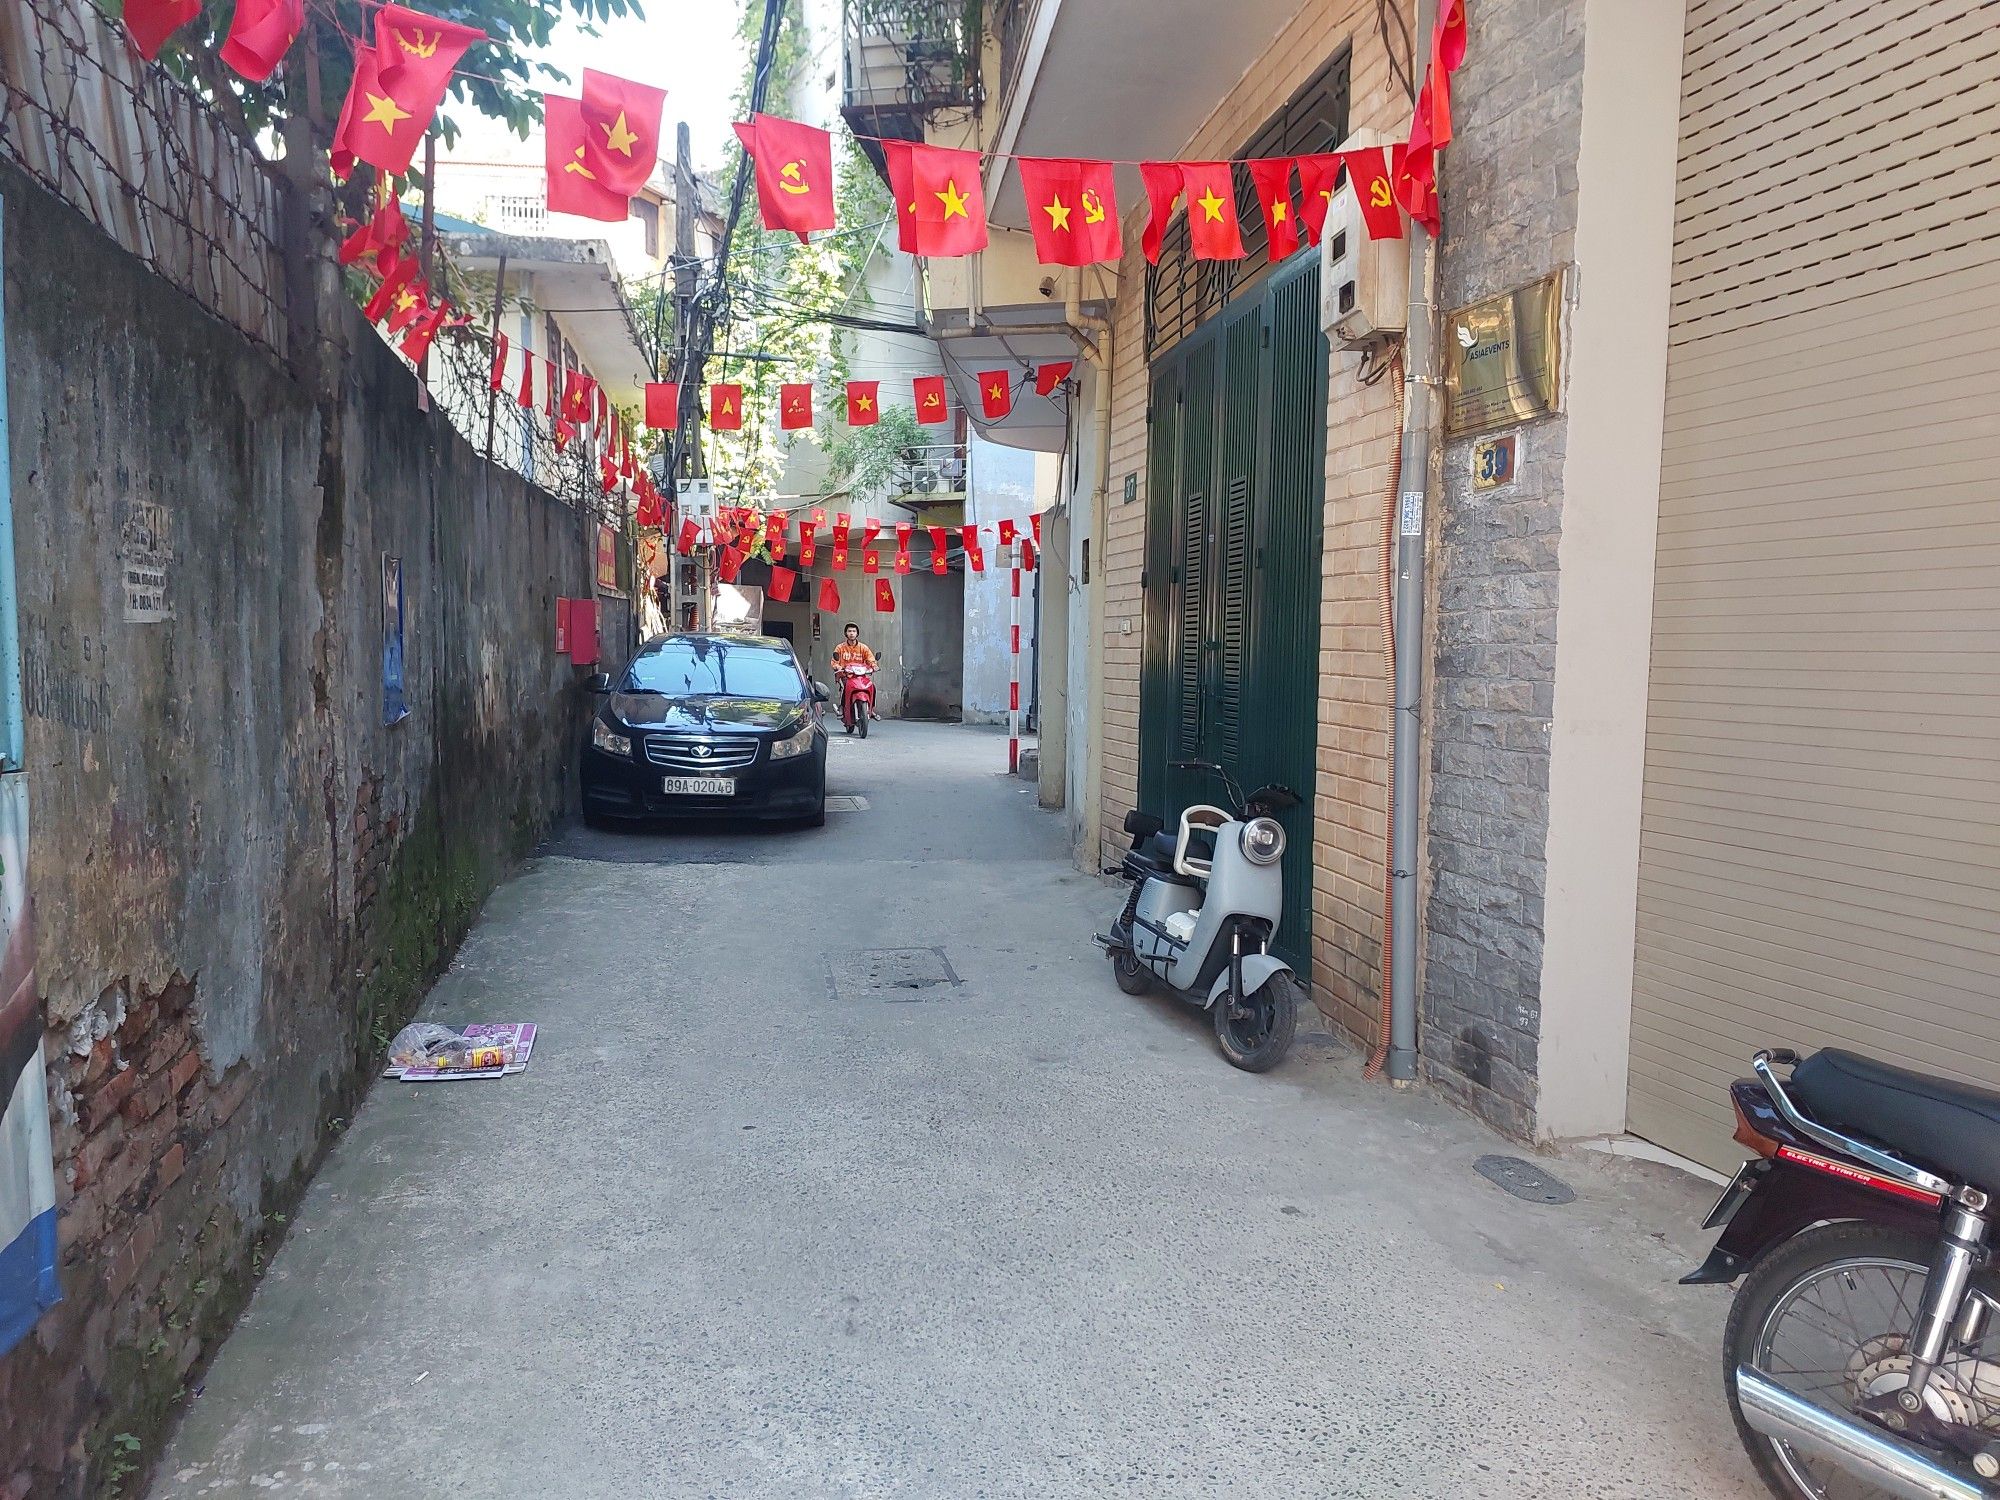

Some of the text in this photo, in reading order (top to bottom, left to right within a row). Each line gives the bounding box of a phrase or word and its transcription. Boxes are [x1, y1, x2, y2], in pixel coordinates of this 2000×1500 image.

[1470, 340, 1510, 361] ASIAEVENTS
[666, 779, 732, 794] 89A-020.46
[1787, 1152, 1871, 1181] ELECTRIC STARTER
